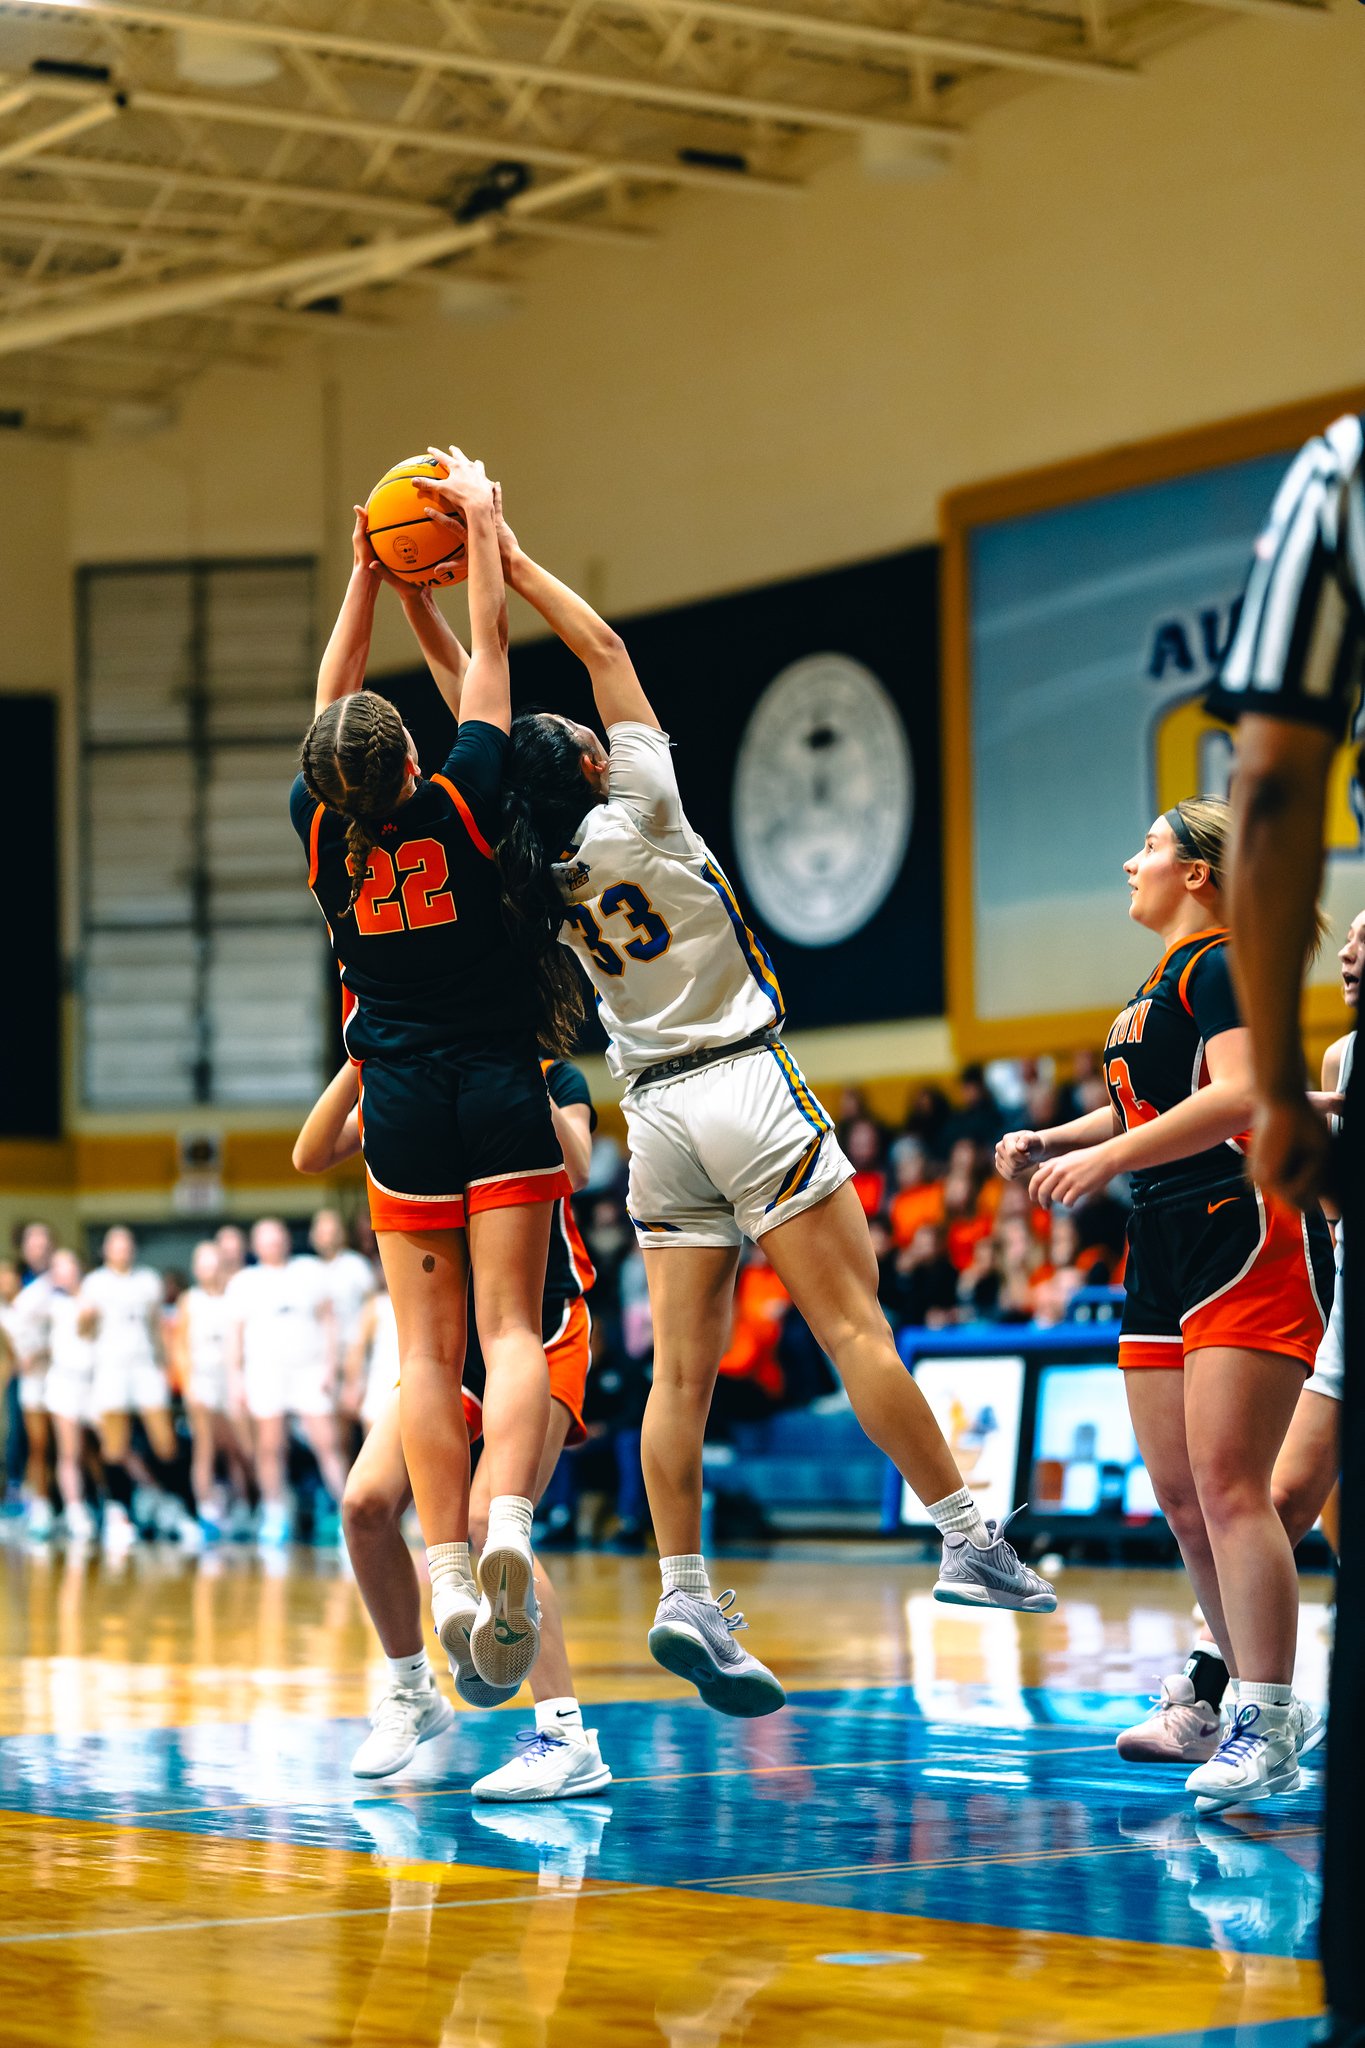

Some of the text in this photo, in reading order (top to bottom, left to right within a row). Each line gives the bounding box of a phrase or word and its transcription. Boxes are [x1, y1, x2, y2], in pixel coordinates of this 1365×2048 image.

[345, 838, 457, 935] 22
[562, 880, 673, 977] 33
[1103, 1057, 1160, 1133] 2
